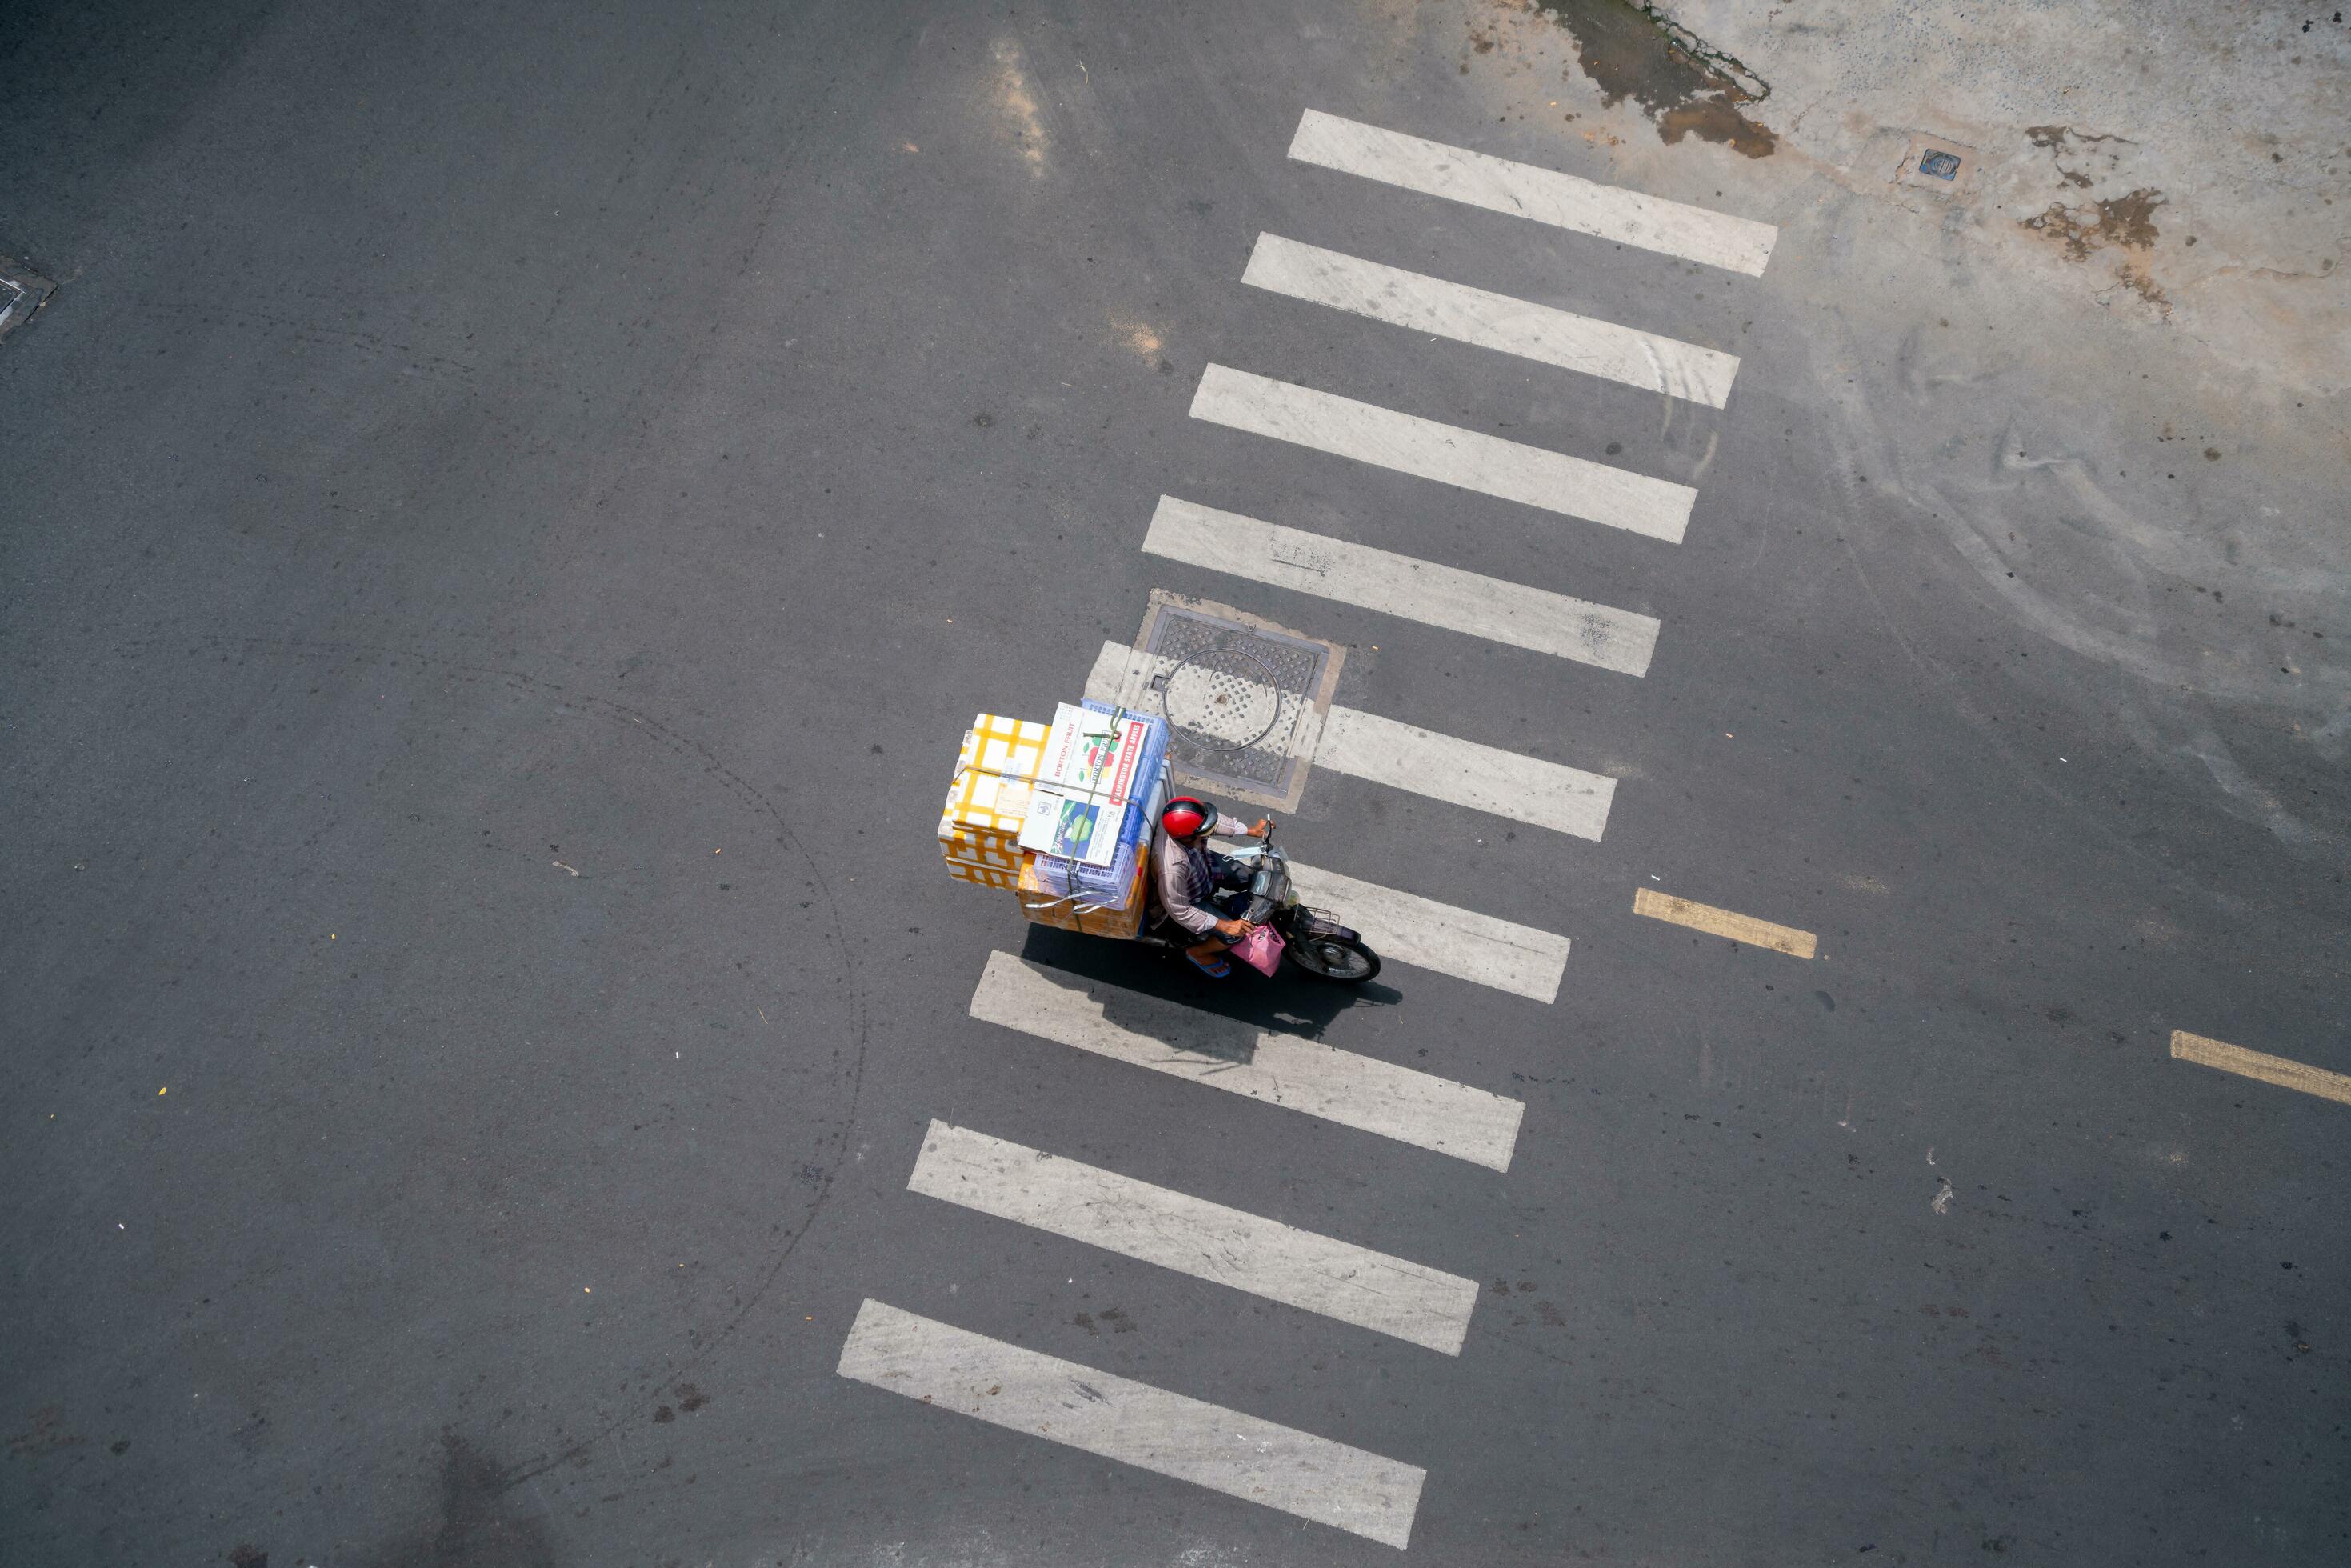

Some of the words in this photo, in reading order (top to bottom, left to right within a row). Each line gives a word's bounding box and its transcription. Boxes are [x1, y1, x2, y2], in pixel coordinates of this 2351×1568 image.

[1054, 745, 1069, 777] BORTON
[1064, 722, 1074, 744] FRUIT
[1123, 744, 1134, 762] STATE
[1129, 724, 1140, 744] APPLES
[1091, 754, 1104, 782] BORTON
